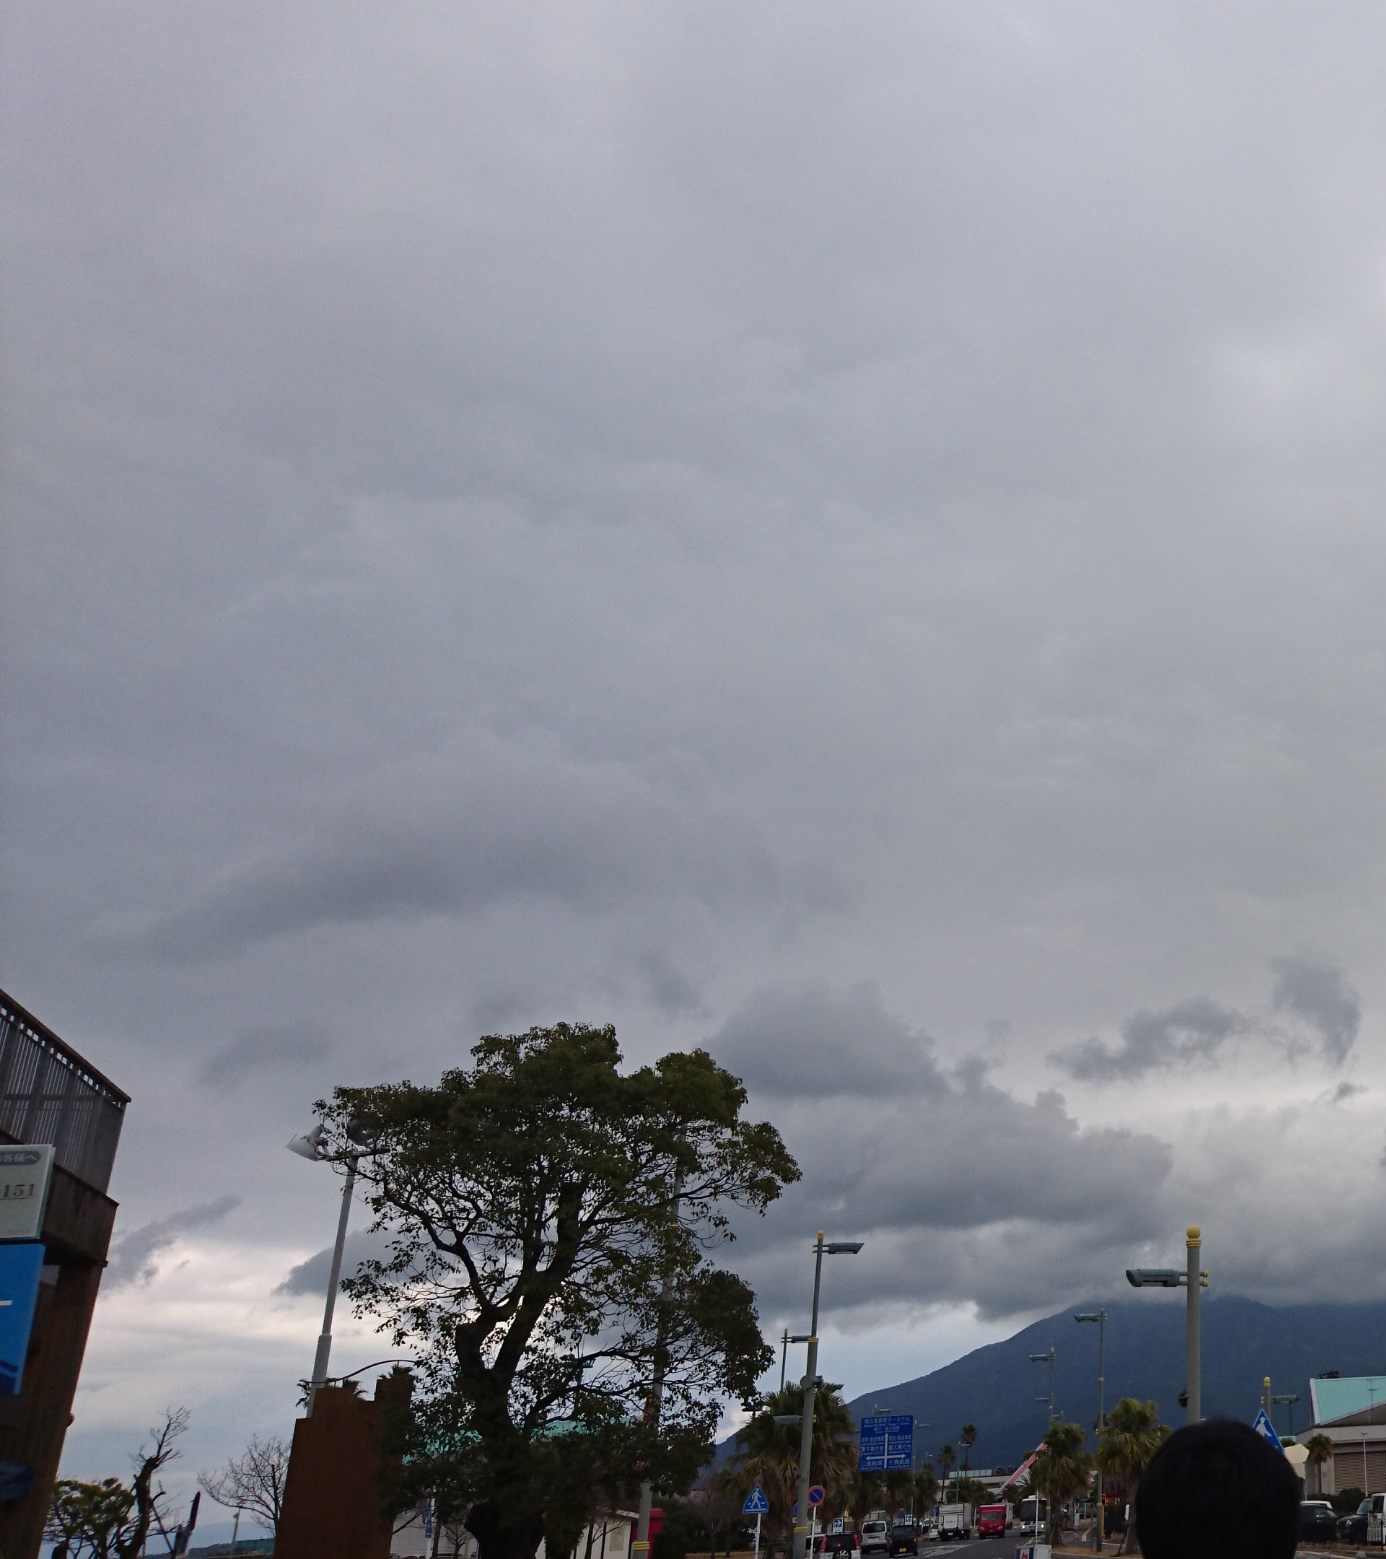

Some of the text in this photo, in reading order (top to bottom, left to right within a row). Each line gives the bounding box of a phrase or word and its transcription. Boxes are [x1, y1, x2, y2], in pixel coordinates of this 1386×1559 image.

[0, 1152, 37, 1163] 客様へ
[3, 1184, 35, 1198] 151
